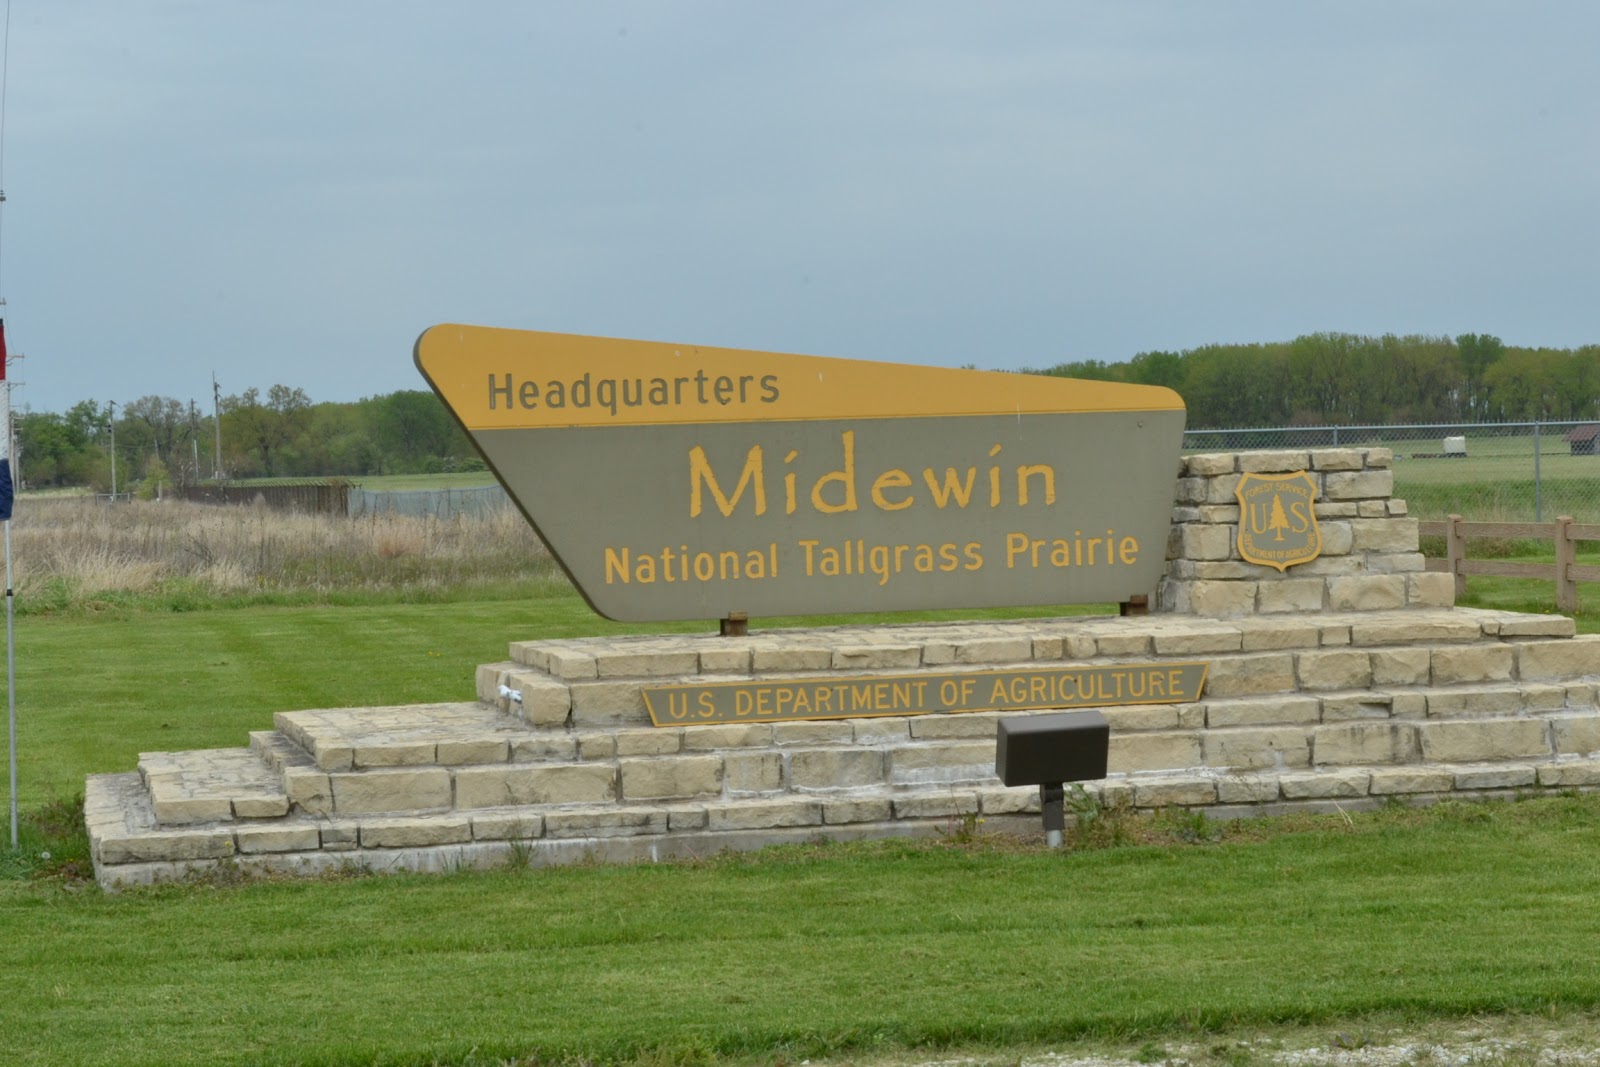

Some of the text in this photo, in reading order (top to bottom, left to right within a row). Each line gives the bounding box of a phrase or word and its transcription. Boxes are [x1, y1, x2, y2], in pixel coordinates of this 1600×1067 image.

[488, 369, 780, 416] Headquarters
[688, 430, 1056, 518] Midewin
[1245, 482, 1309, 500] FOREST SERVICE
[1250, 501, 1309, 534] U S
[604, 529, 1140, 586] National Tallgrass Prairie
[668, 669, 1184, 719] U.S. DEPARTMENT OF AGRICULTURE
